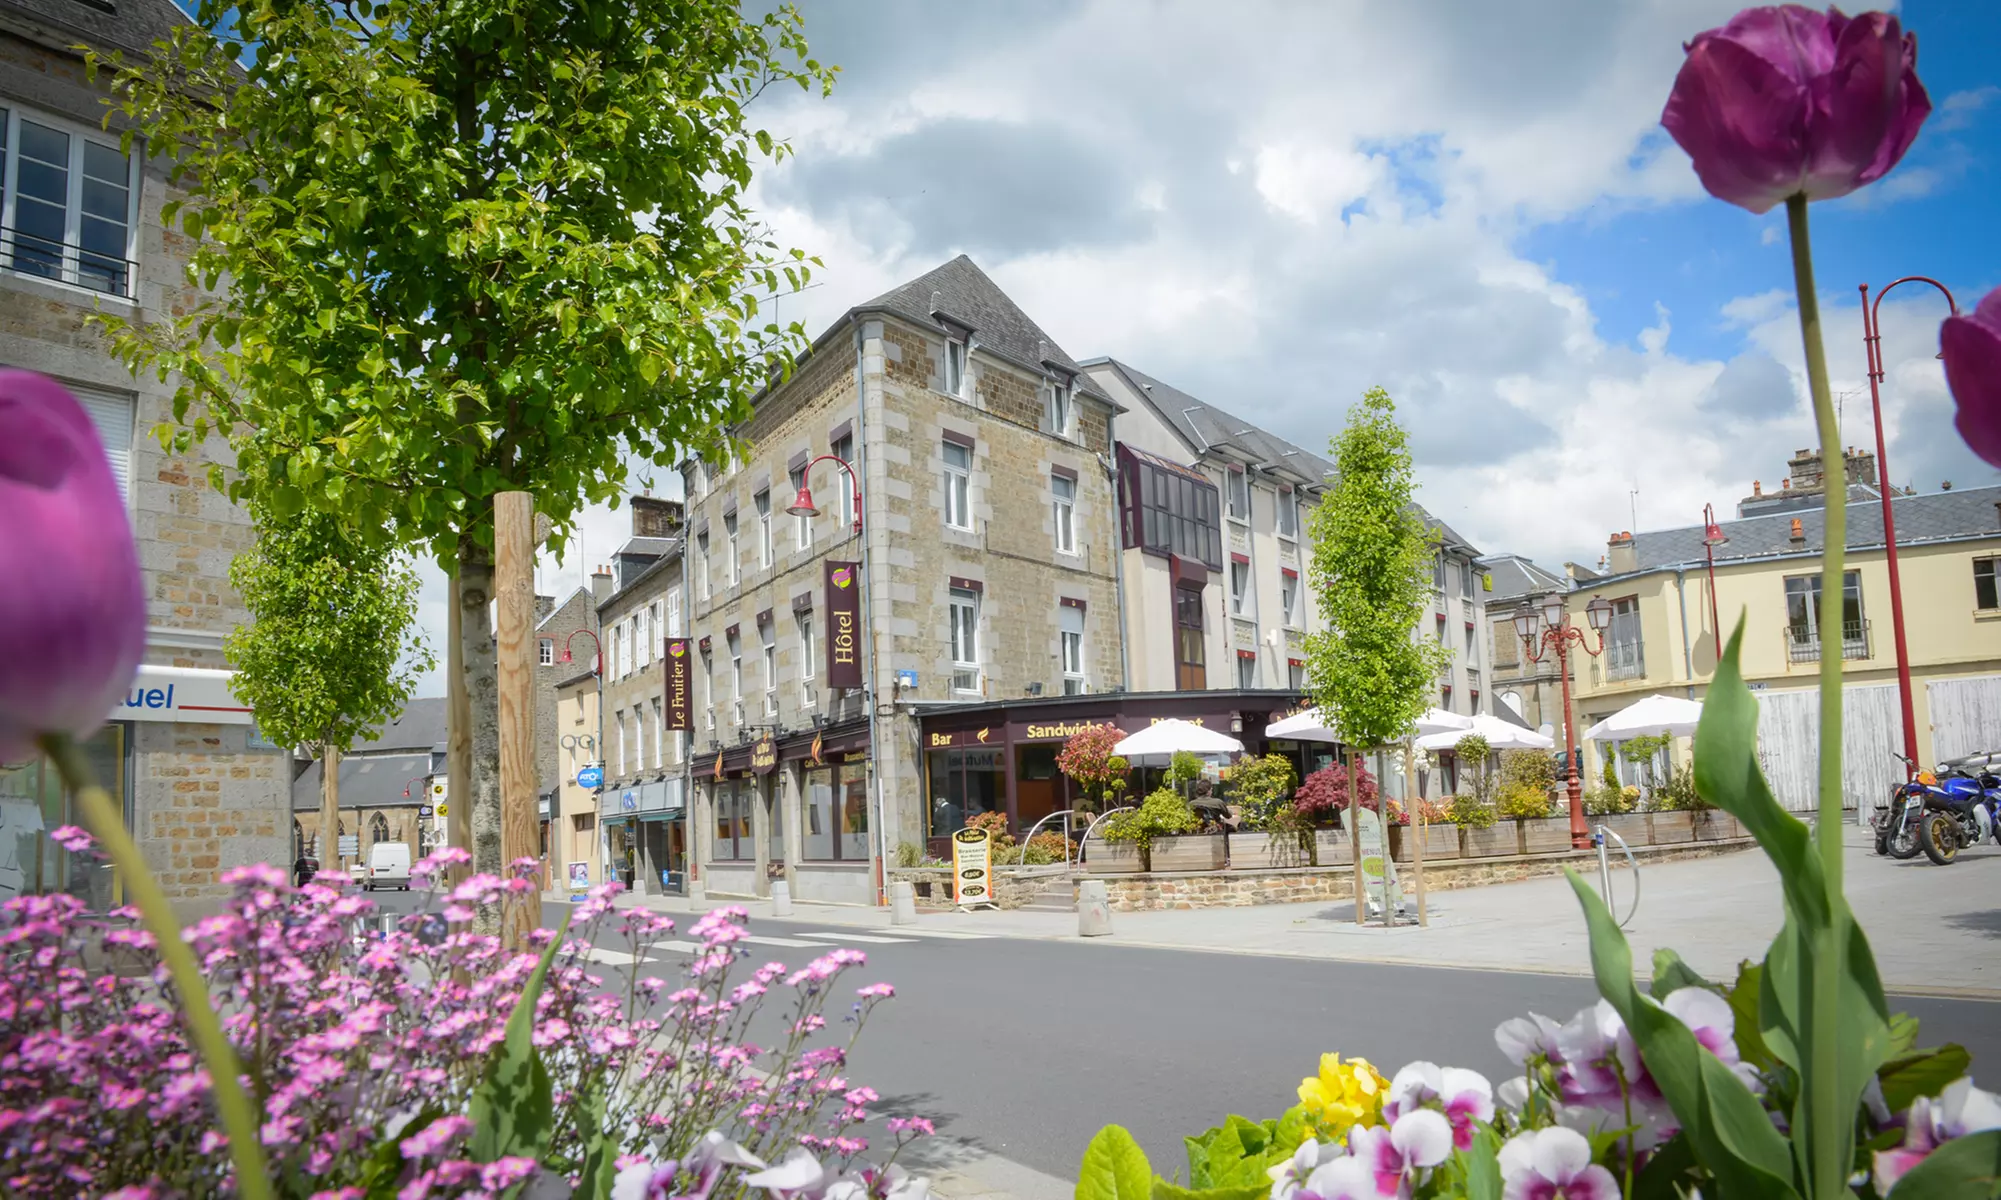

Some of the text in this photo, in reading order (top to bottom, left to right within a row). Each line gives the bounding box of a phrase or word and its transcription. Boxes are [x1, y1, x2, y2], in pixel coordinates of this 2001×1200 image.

[833, 609, 854, 665] Hôtel
[119, 684, 175, 709] uel
[671, 661, 686, 729] Le Fruitier
[931, 732, 953, 746] Bar
[1027, 720, 1104, 738] Sandwichs
